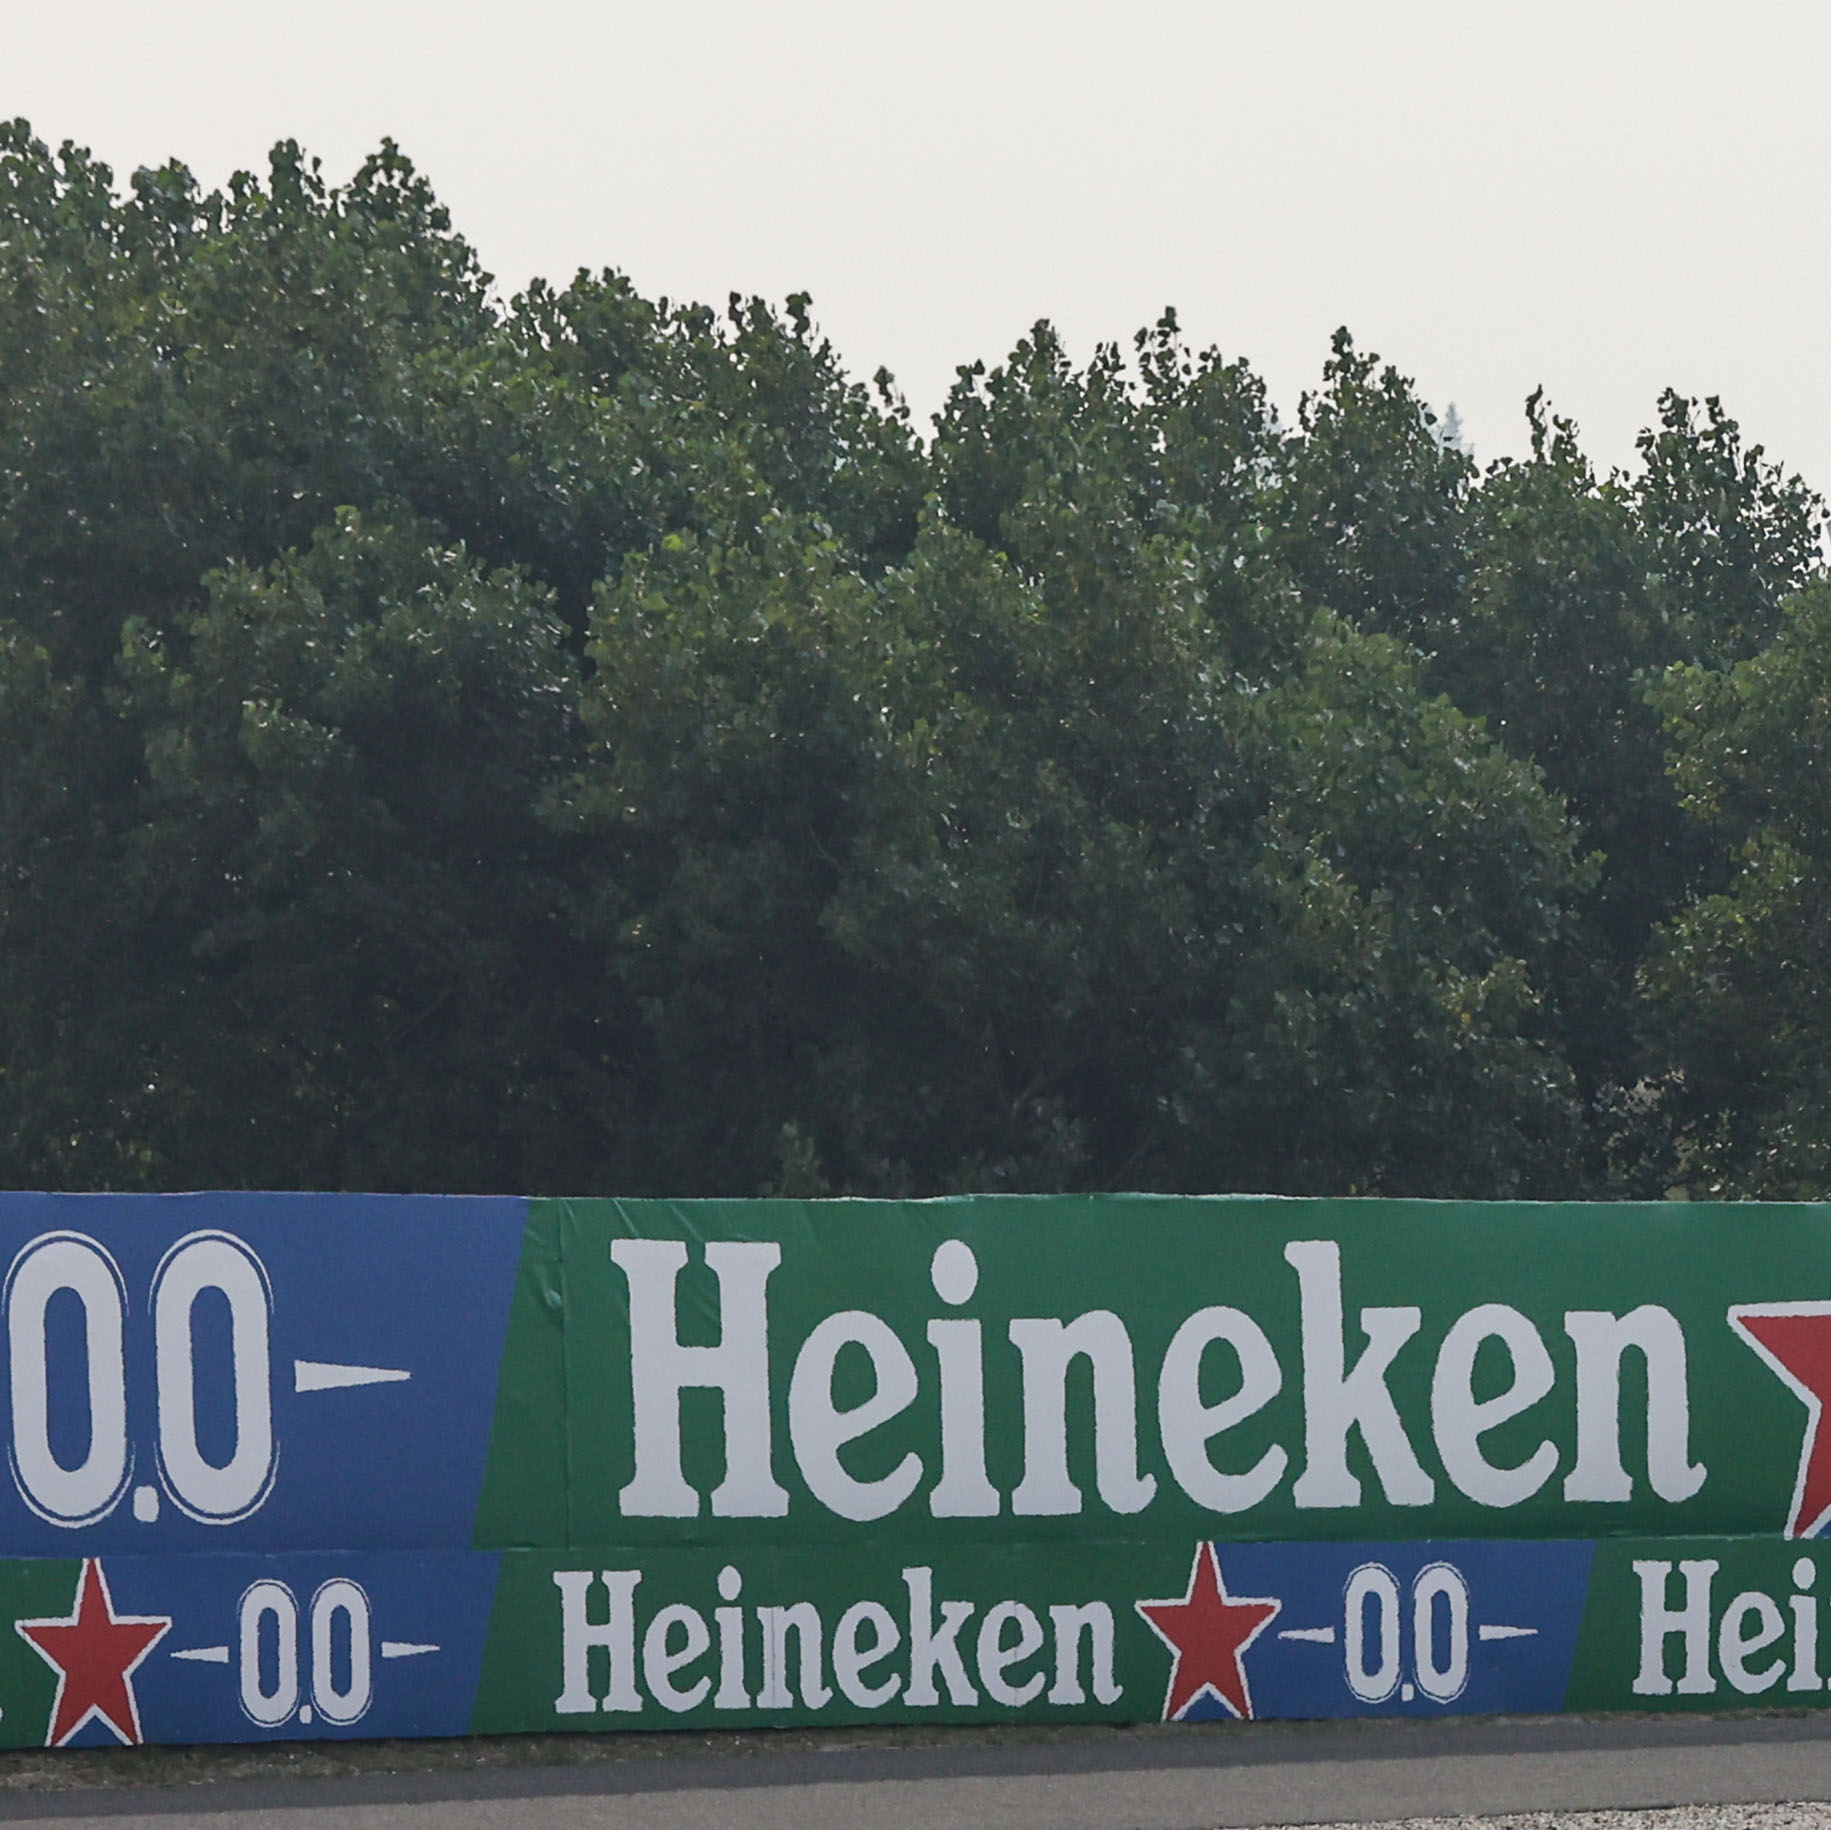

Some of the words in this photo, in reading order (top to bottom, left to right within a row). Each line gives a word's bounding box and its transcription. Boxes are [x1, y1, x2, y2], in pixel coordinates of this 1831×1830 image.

[5, 1236, 273, 1524] 0.0
[611, 1239, 1706, 1521] Heineken
[240, 1580, 371, 1726] 0.0
[554, 1567, 1122, 1713] Heineken
[1344, 1563, 1470, 1702] 0.0
